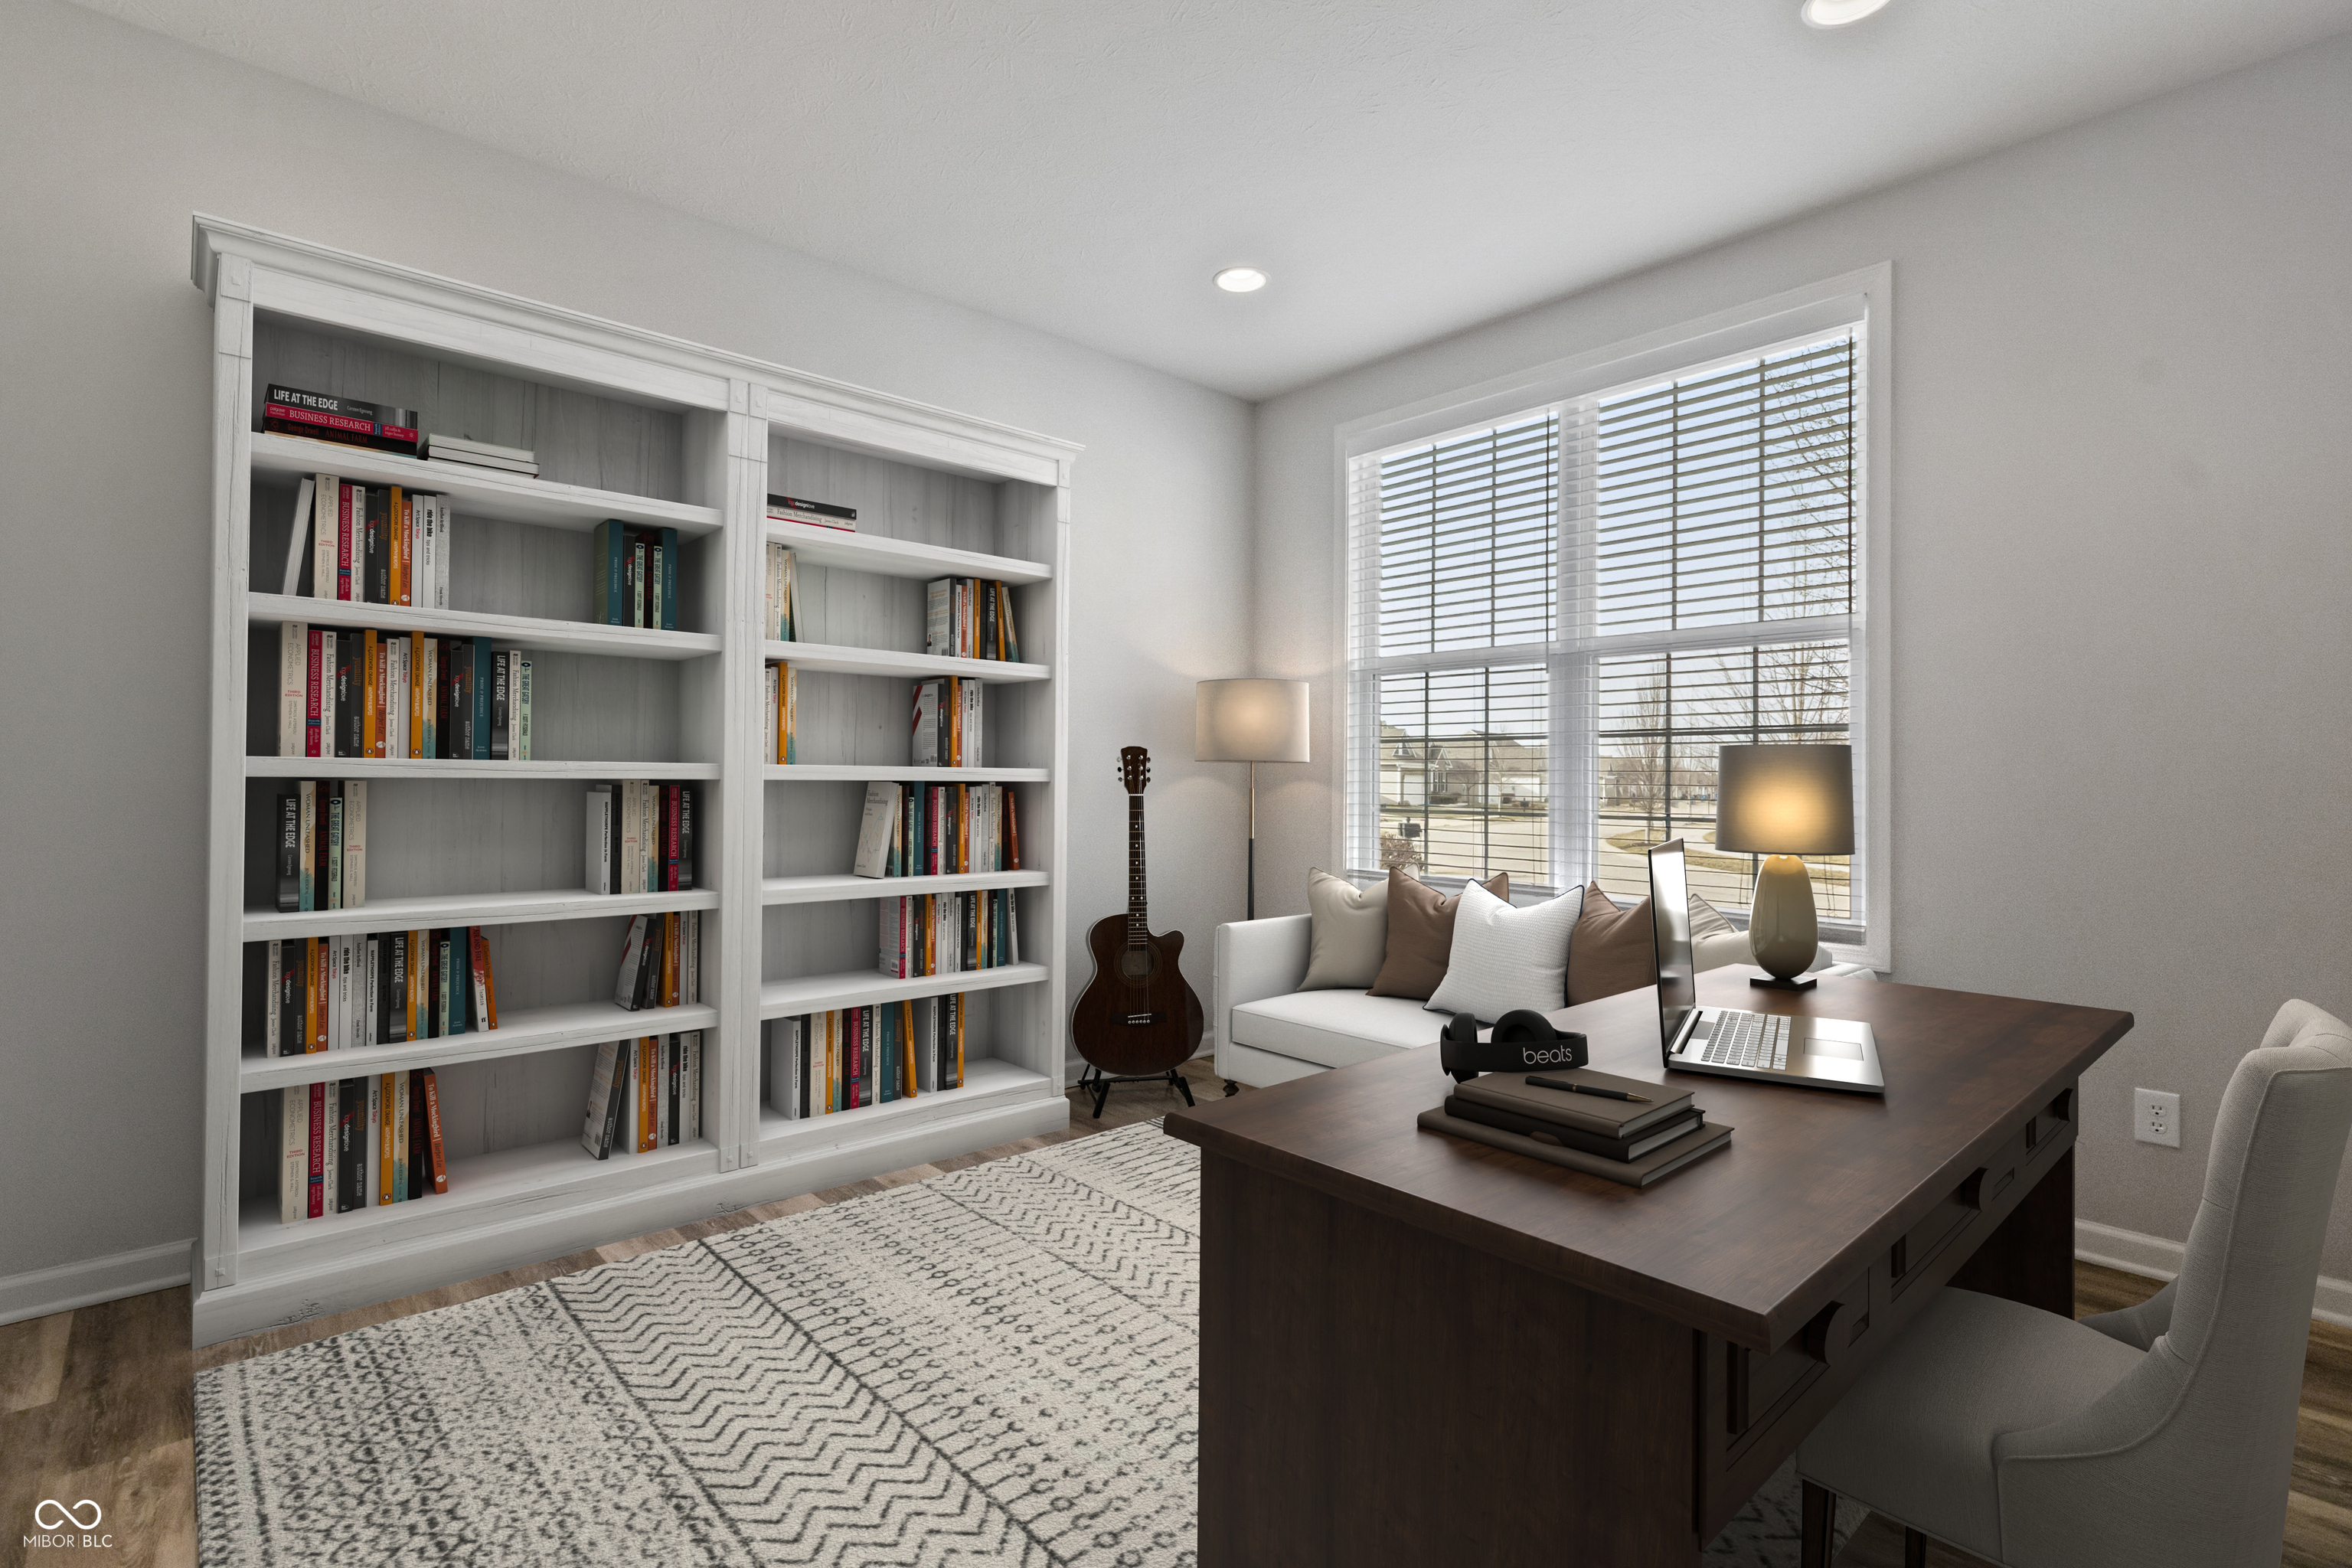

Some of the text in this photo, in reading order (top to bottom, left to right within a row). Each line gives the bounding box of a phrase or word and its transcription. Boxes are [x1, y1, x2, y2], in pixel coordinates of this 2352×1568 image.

[274, 389, 290, 402] LIFE
[291, 393, 301, 404] AT
[302, 394, 317, 407] THE
[318, 397, 338, 410] EDGE
[289, 410, 328, 424] BUSINESS
[329, 416, 371, 432] RESEARCH
[325, 429, 349, 442] ANIMAL
[351, 433, 368, 444] FARM
[341, 532, 349, 567] RESEARCH
[353, 527, 362, 564] Merchandising
[497, 655, 505, 667] LIFE
[310, 648, 319, 716] BUSINESS RESEARCH
[496, 675, 505, 686] THE
[323, 675, 334, 713] Merchandising
[387, 679, 397, 716] Merchandising
[496, 686, 505, 701] EDGE
[286, 799, 296, 811] LIFE
[286, 819, 296, 831] THE
[286, 832, 296, 848] EDGE
[395, 937, 404, 949] LIFE
[394, 956, 403, 968] THE
[394, 969, 403, 983] EDGE
[270, 979, 279, 1015] Merchandising
[1522, 1044, 1573, 1065] beats
[328, 1102, 337, 1124] Fashion
[430, 1105, 441, 1138] Mockingbird
[313, 1100, 322, 1173] BUSINESS RESEARCH
[325, 1125, 337, 1165] Merchandising
